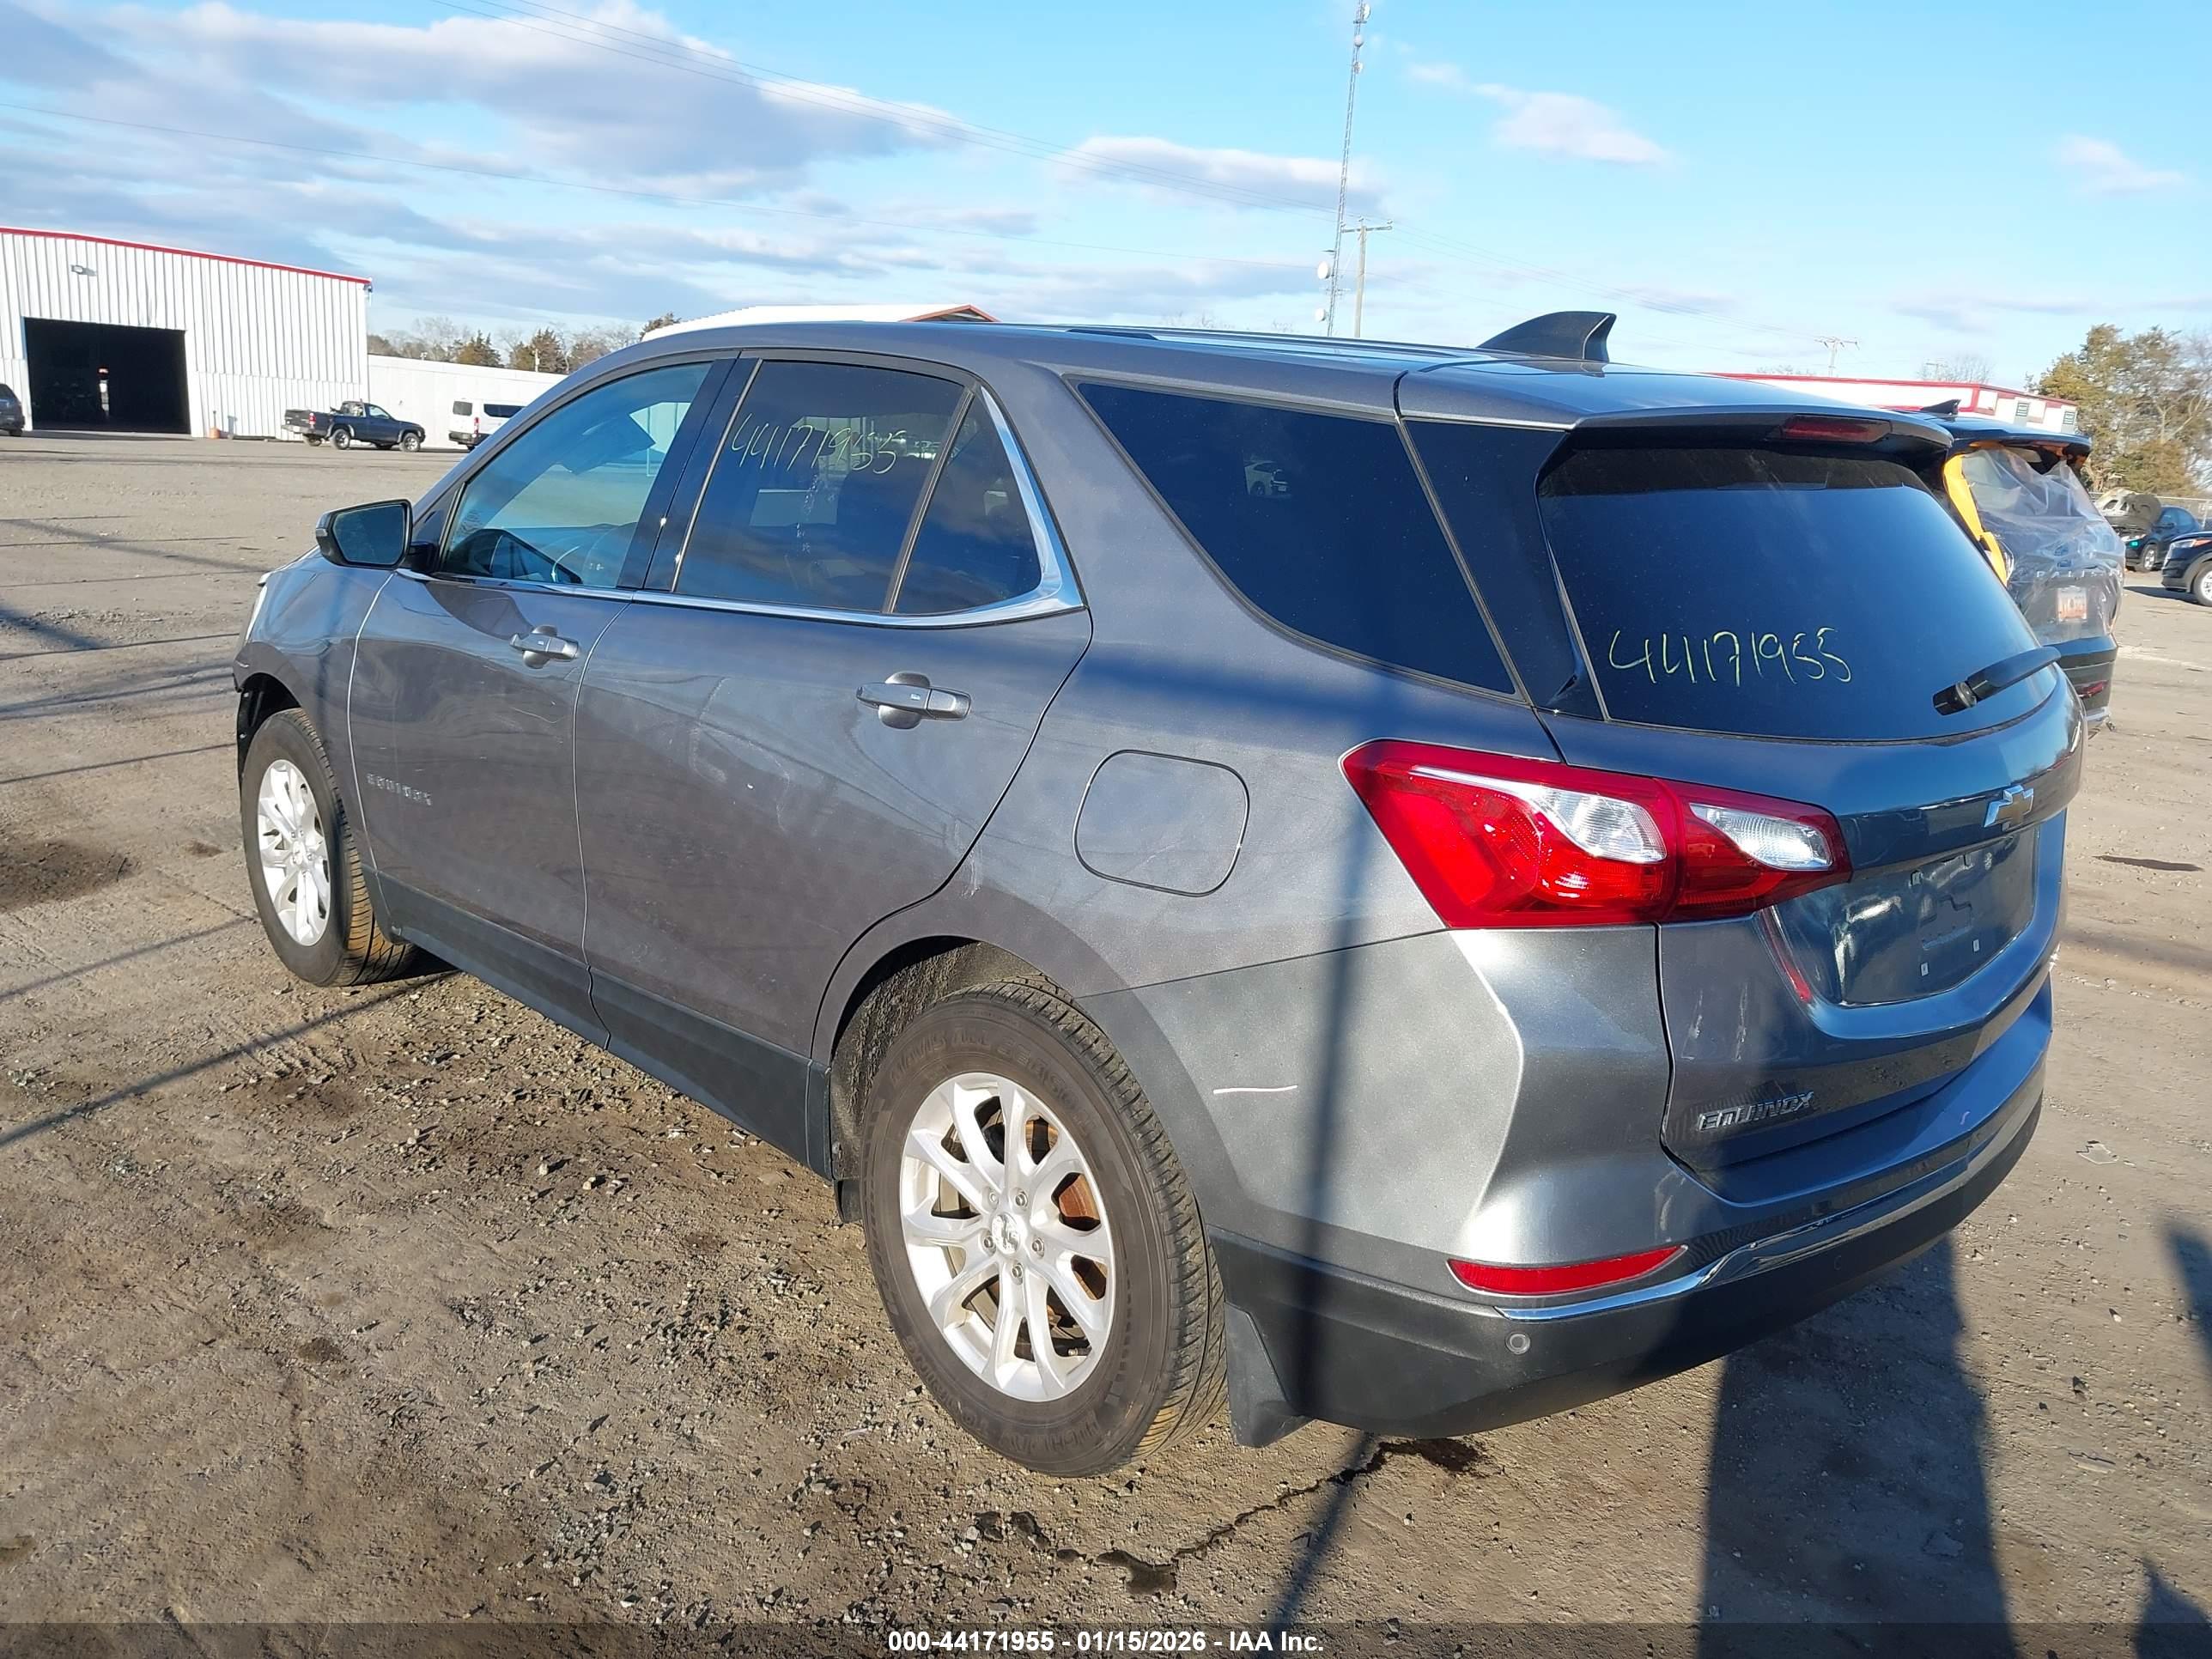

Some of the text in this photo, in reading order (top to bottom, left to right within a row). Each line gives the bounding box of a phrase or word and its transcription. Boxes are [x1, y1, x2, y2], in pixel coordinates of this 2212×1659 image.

[732, 412, 907, 474] 44171955
[1609, 627, 1851, 687] 44171955
[1697, 1091, 1814, 1131] EQUINOX
